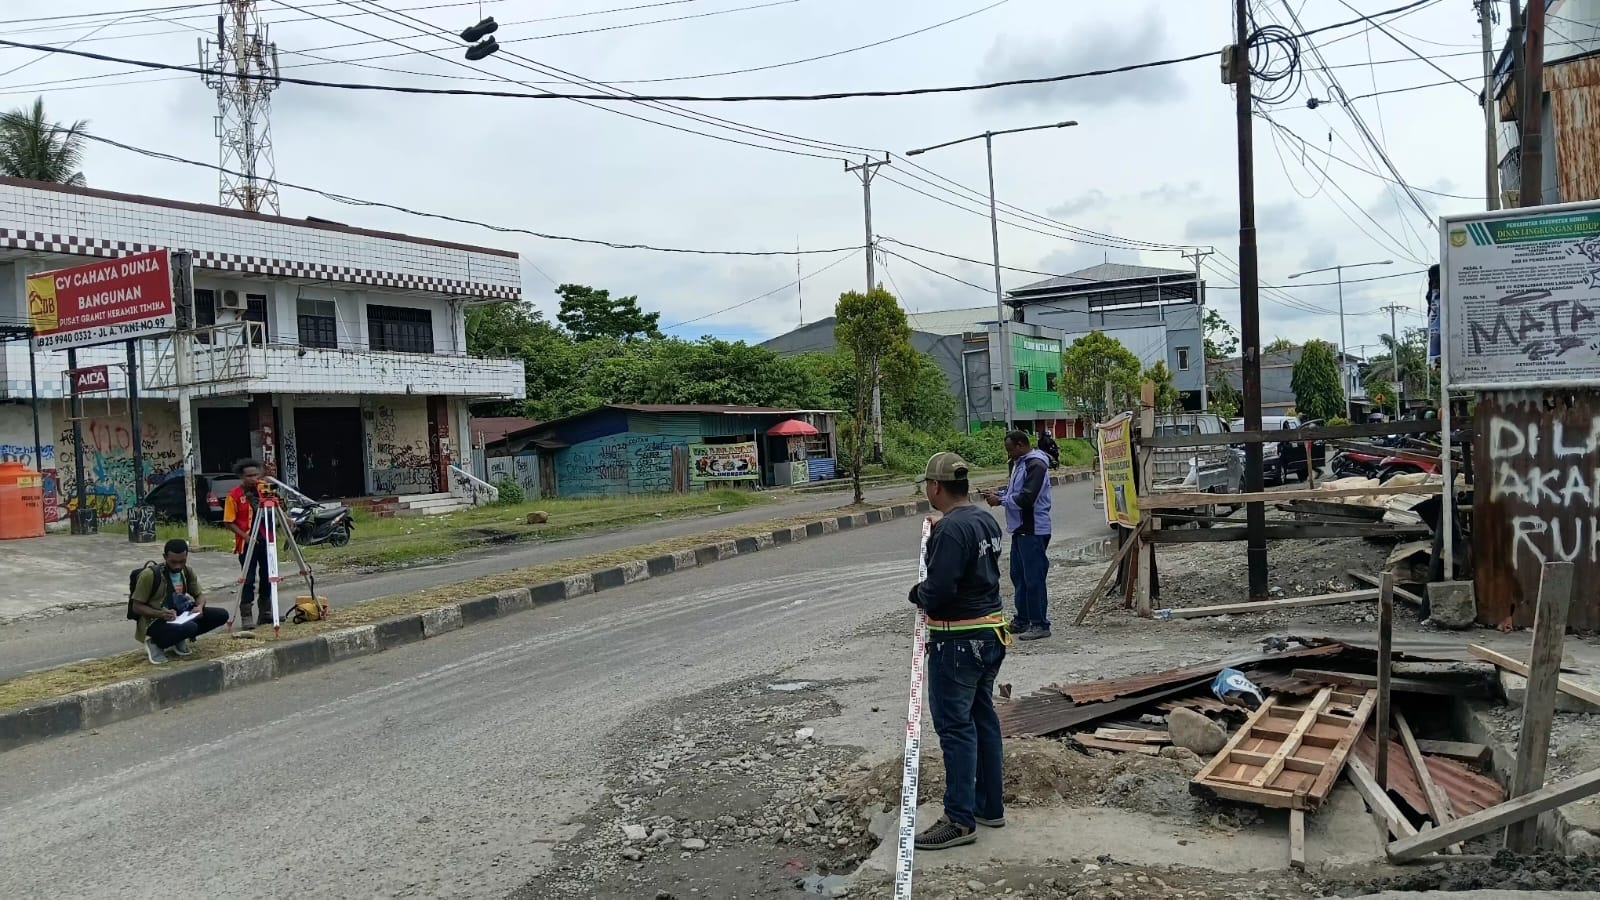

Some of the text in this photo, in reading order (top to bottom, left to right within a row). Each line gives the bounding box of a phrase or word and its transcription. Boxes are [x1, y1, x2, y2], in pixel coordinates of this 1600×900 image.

[1497, 229, 1520, 238] DINAS
[1521, 224, 1573, 236] LINGKUNGAN
[1574, 222, 1599, 231] HIDUP
[55, 257, 160, 290] CV CAHAYA DUNIA
[78, 285, 142, 310] BANGUNAN
[60, 301, 165, 327] PUSAT GRANIT KERAMIK TIMIKA
[55, 333, 73, 343] 9940
[74, 330, 92, 342] 0332
[98, 328, 107, 338] JL
[119, 323, 139, 334] YANI
[1470, 299, 1595, 355] MATA
[78, 371, 106, 386] AICA
[1489, 461, 1600, 508] AKA
